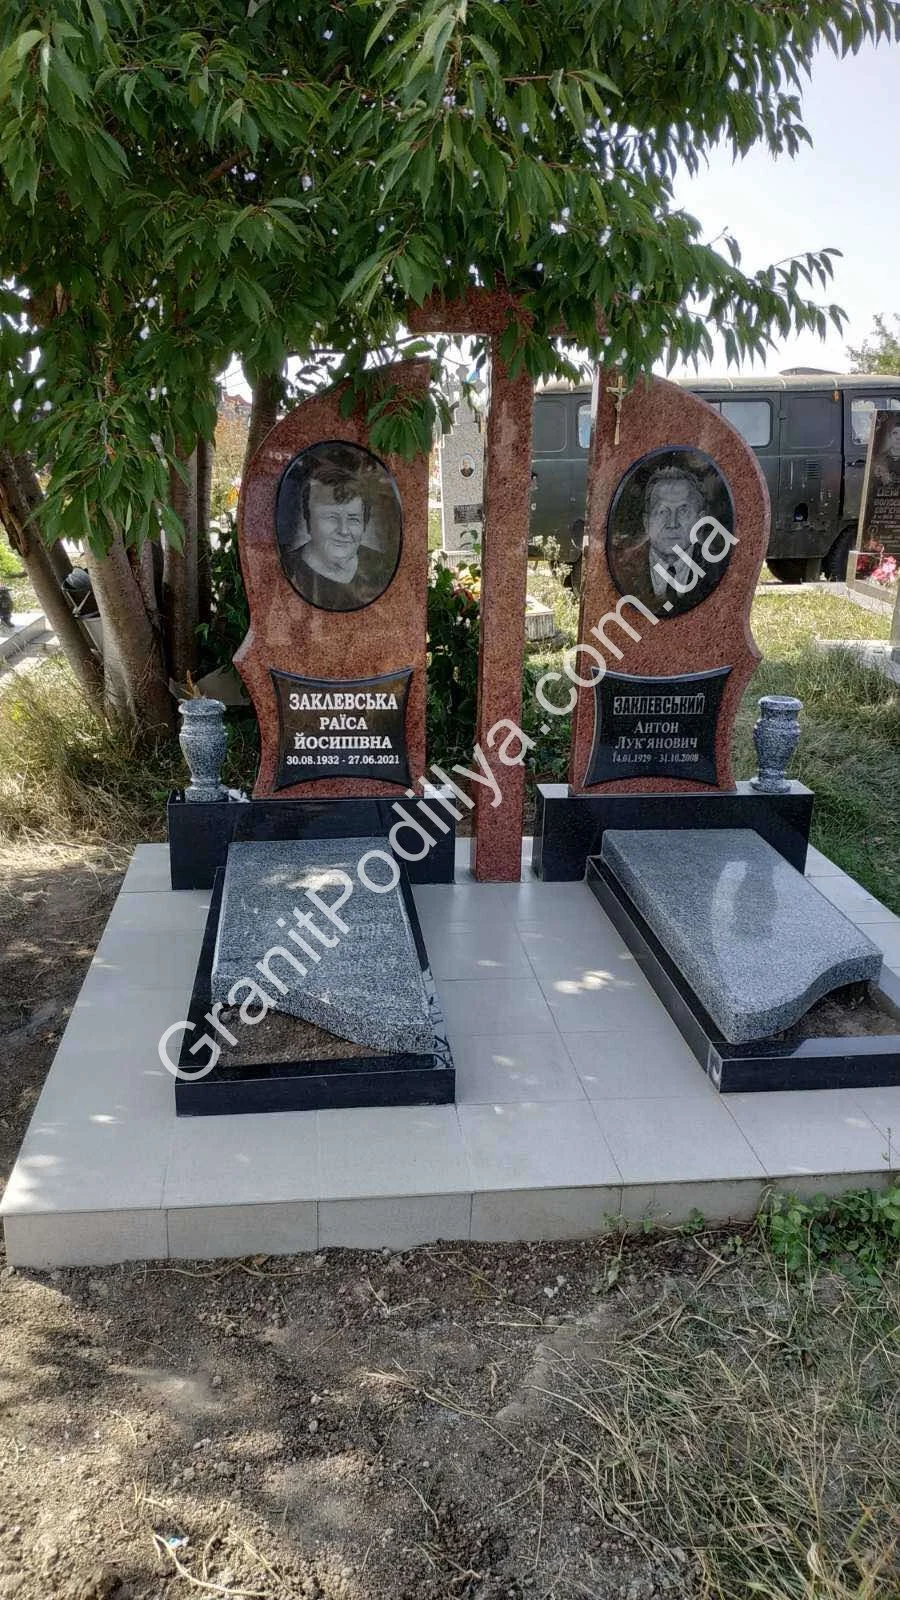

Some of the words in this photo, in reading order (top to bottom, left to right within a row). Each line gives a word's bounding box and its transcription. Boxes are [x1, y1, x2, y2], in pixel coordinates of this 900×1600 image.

[289, 693, 398, 710] ЗАКЛЕВСЬКА
[613, 693, 706, 715] ЗАКЛЕВСЬКИЙ
[319, 714, 368, 730] РАЇСА
[293, 732, 393, 750] ЙОСИПІВНА
[286, 755, 340, 765] 30.08.1932
[348, 755, 400, 765] 27.06.2021
